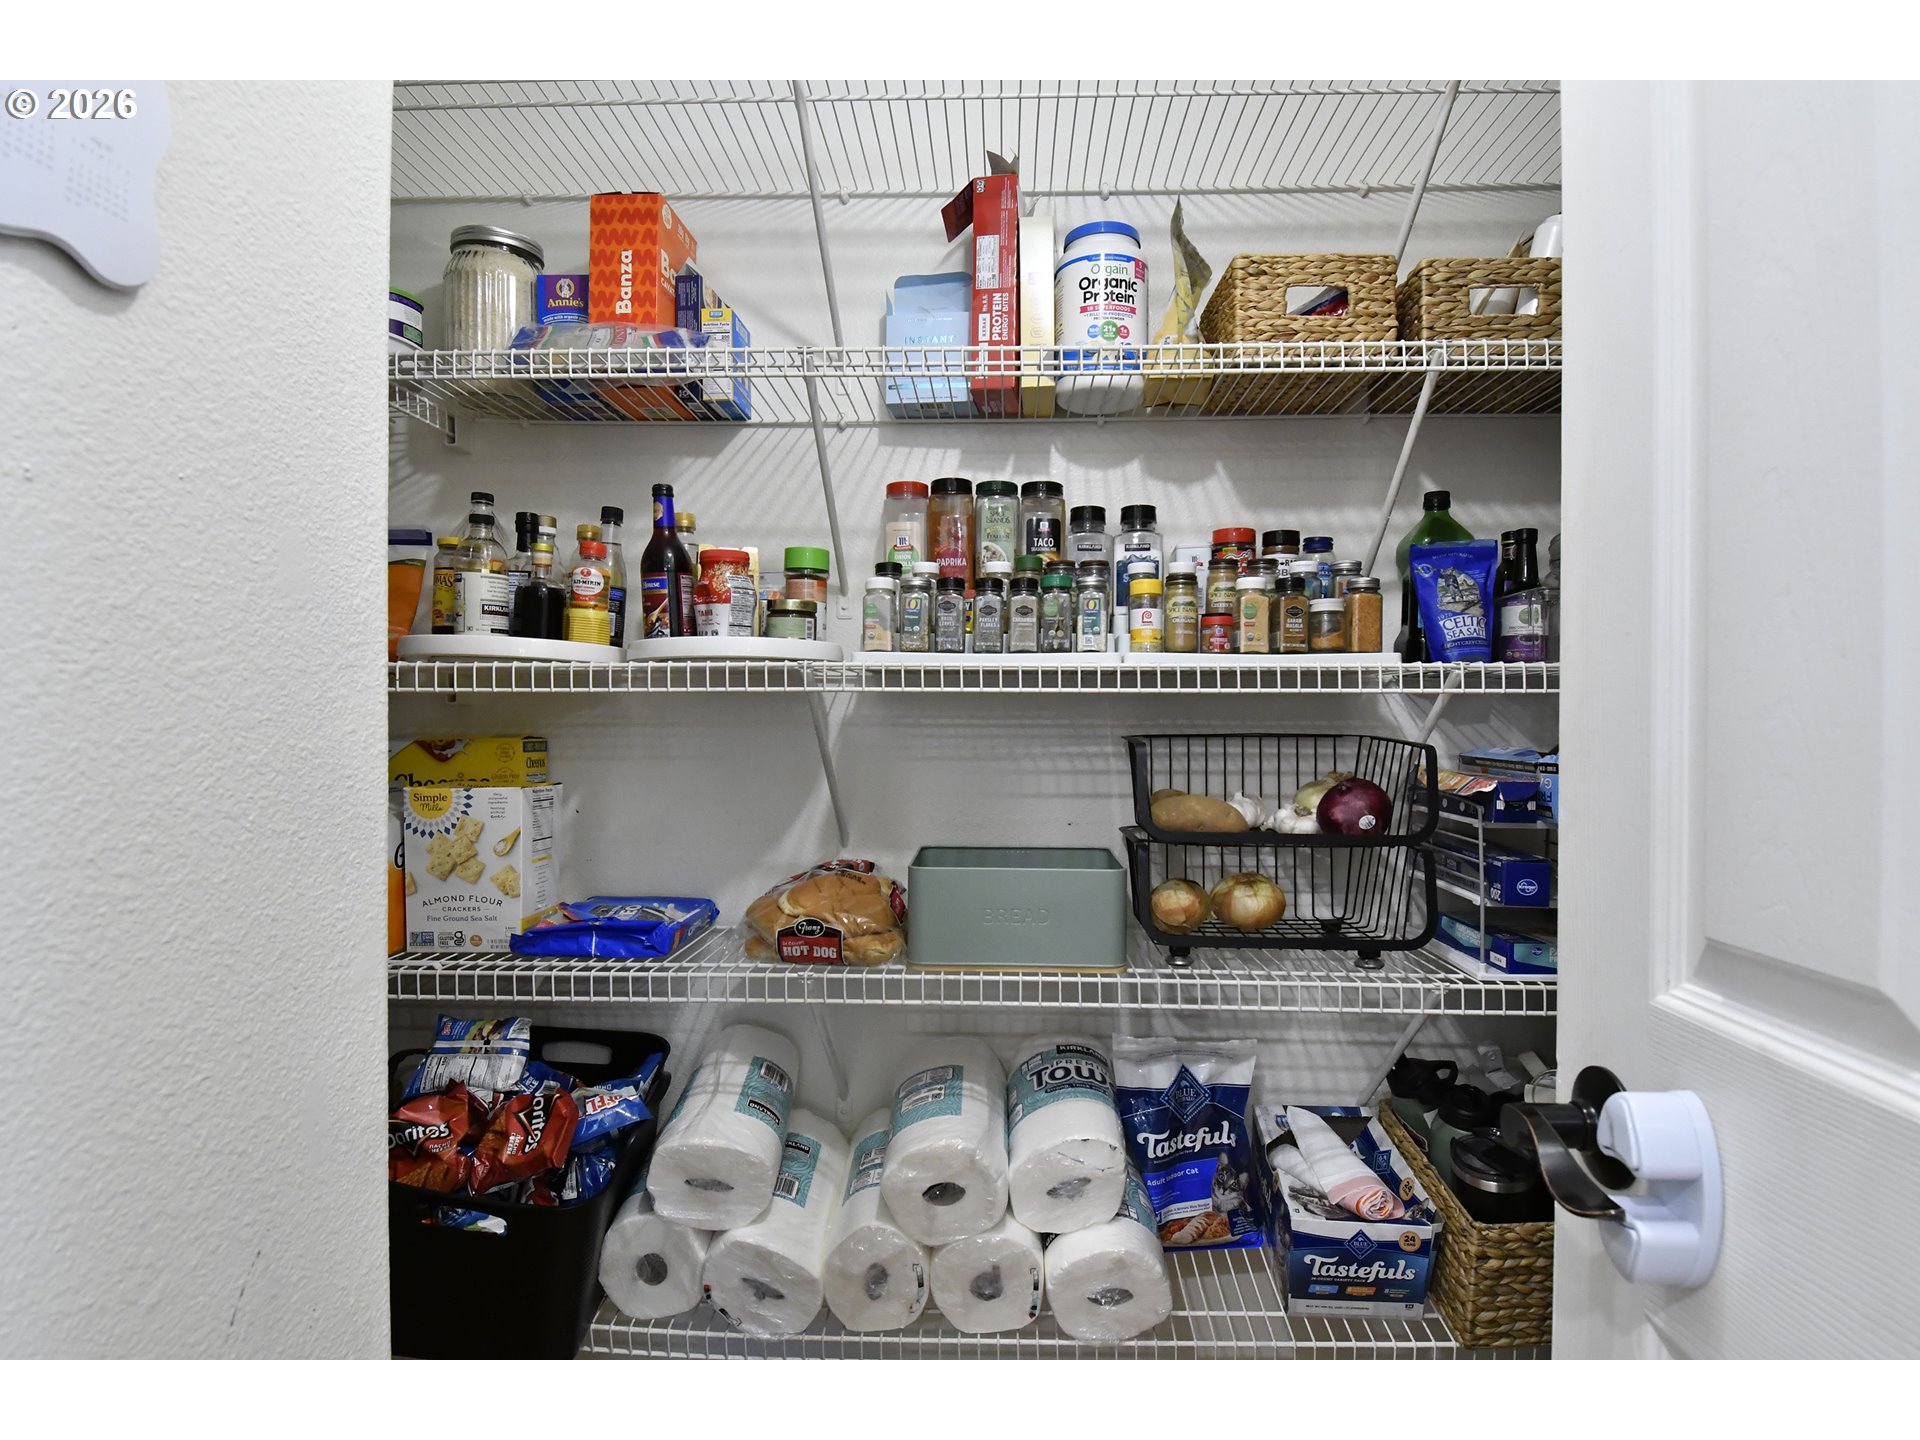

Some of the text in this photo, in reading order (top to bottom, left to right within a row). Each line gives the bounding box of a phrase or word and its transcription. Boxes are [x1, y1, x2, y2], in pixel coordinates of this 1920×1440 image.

[1090, 263, 1129, 276] Ogain
[616, 249, 633, 315] Banza
[547, 297, 584, 308] Annie's
[992, 292, 1002, 341] PROTEIN
[904, 335, 954, 346] INSTANT
[1033, 537, 1055, 547] TACO
[936, 557, 967, 567] PAPRIKA
[1442, 615, 1487, 632] CELTIC
[1445, 627, 1486, 641] SEA SALT
[413, 792, 447, 804] Simple
[1518, 881, 1536, 893] Kroger
[422, 894, 503, 908] ALMOND FLOUR
[443, 915, 469, 923] Ground
[984, 907, 1049, 926] BREAD
[798, 921, 822, 935] Franz
[783, 945, 837, 959] HOT DOG
[1175, 1088, 1197, 1100] BLUE
[749, 1102, 779, 1123] KIRKLAND
[1147, 1167, 1199, 1187] Adult Indoor Cat
[1403, 1180, 1413, 1193] 24
[1403, 1235, 1416, 1243] 24
[1303, 1254, 1416, 1283] Tastefuls
